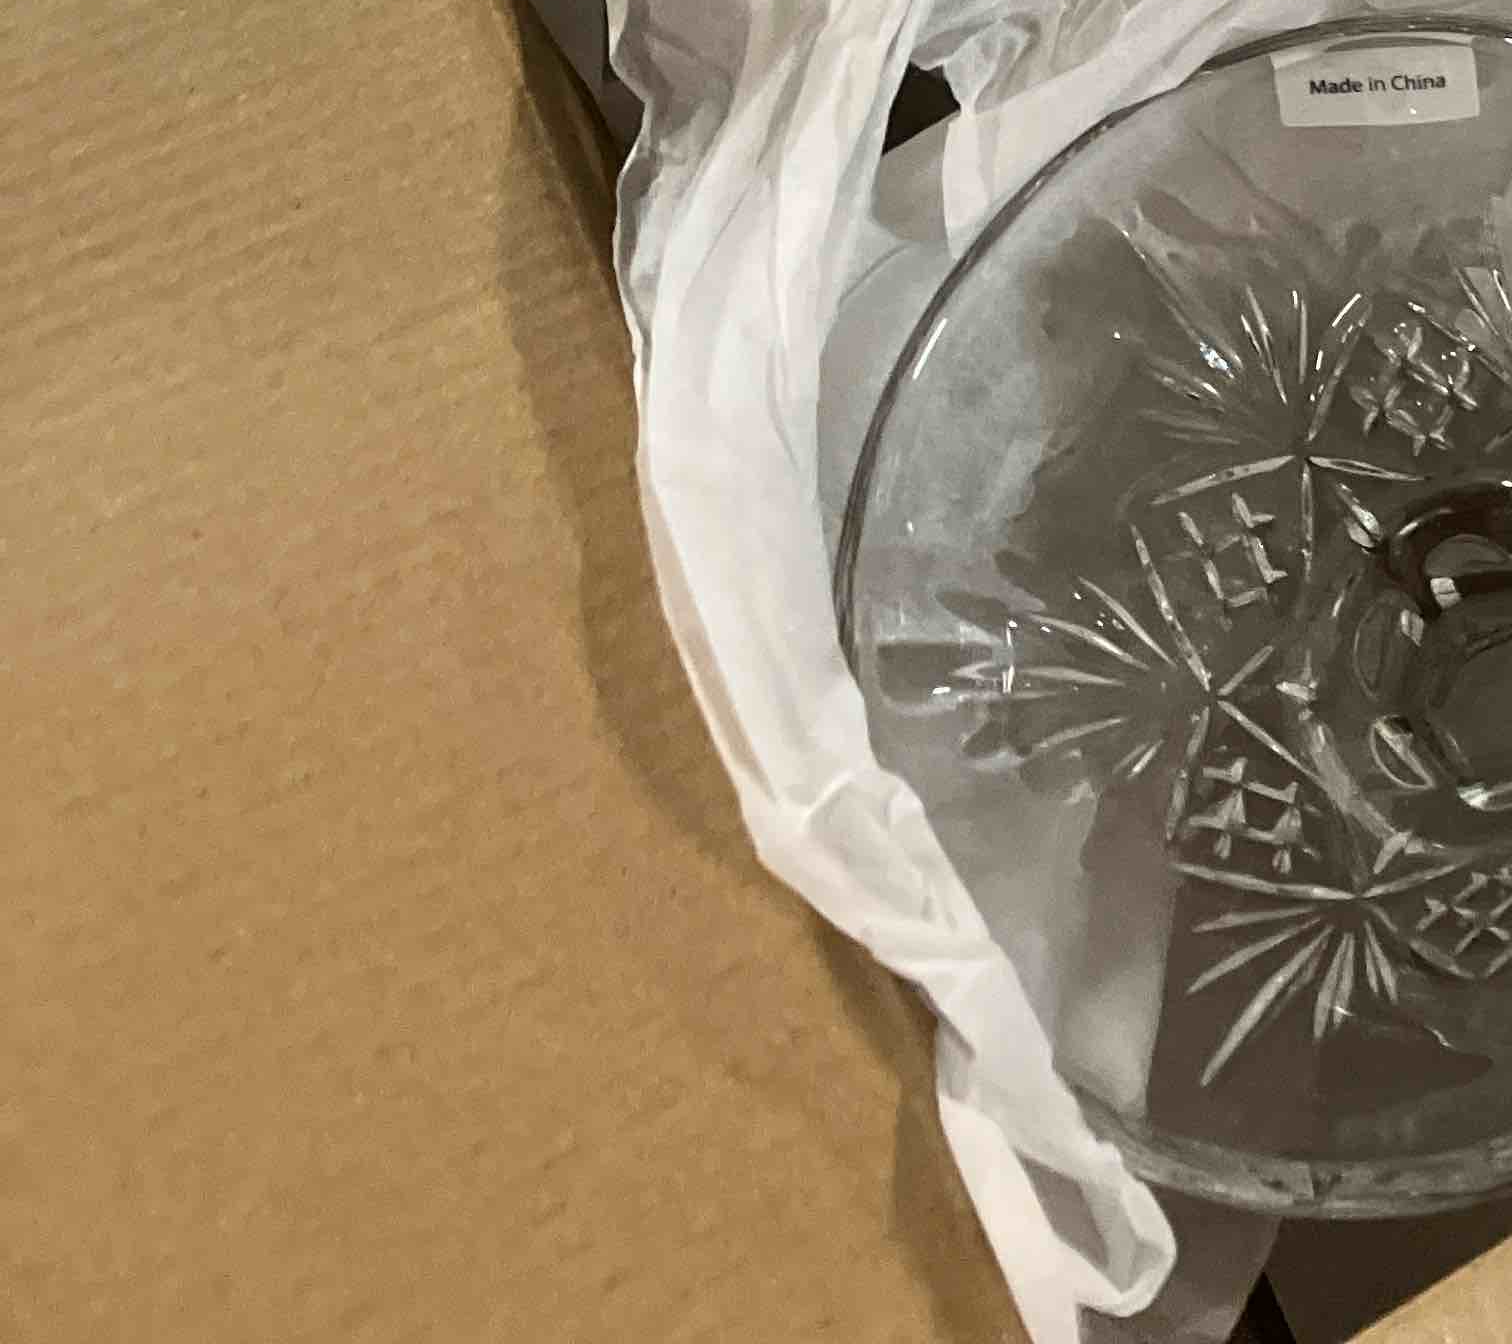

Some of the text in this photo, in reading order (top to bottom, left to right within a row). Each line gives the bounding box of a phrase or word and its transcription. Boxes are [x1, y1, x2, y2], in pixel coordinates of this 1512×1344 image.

[1309, 74, 1447, 95] Made in China
